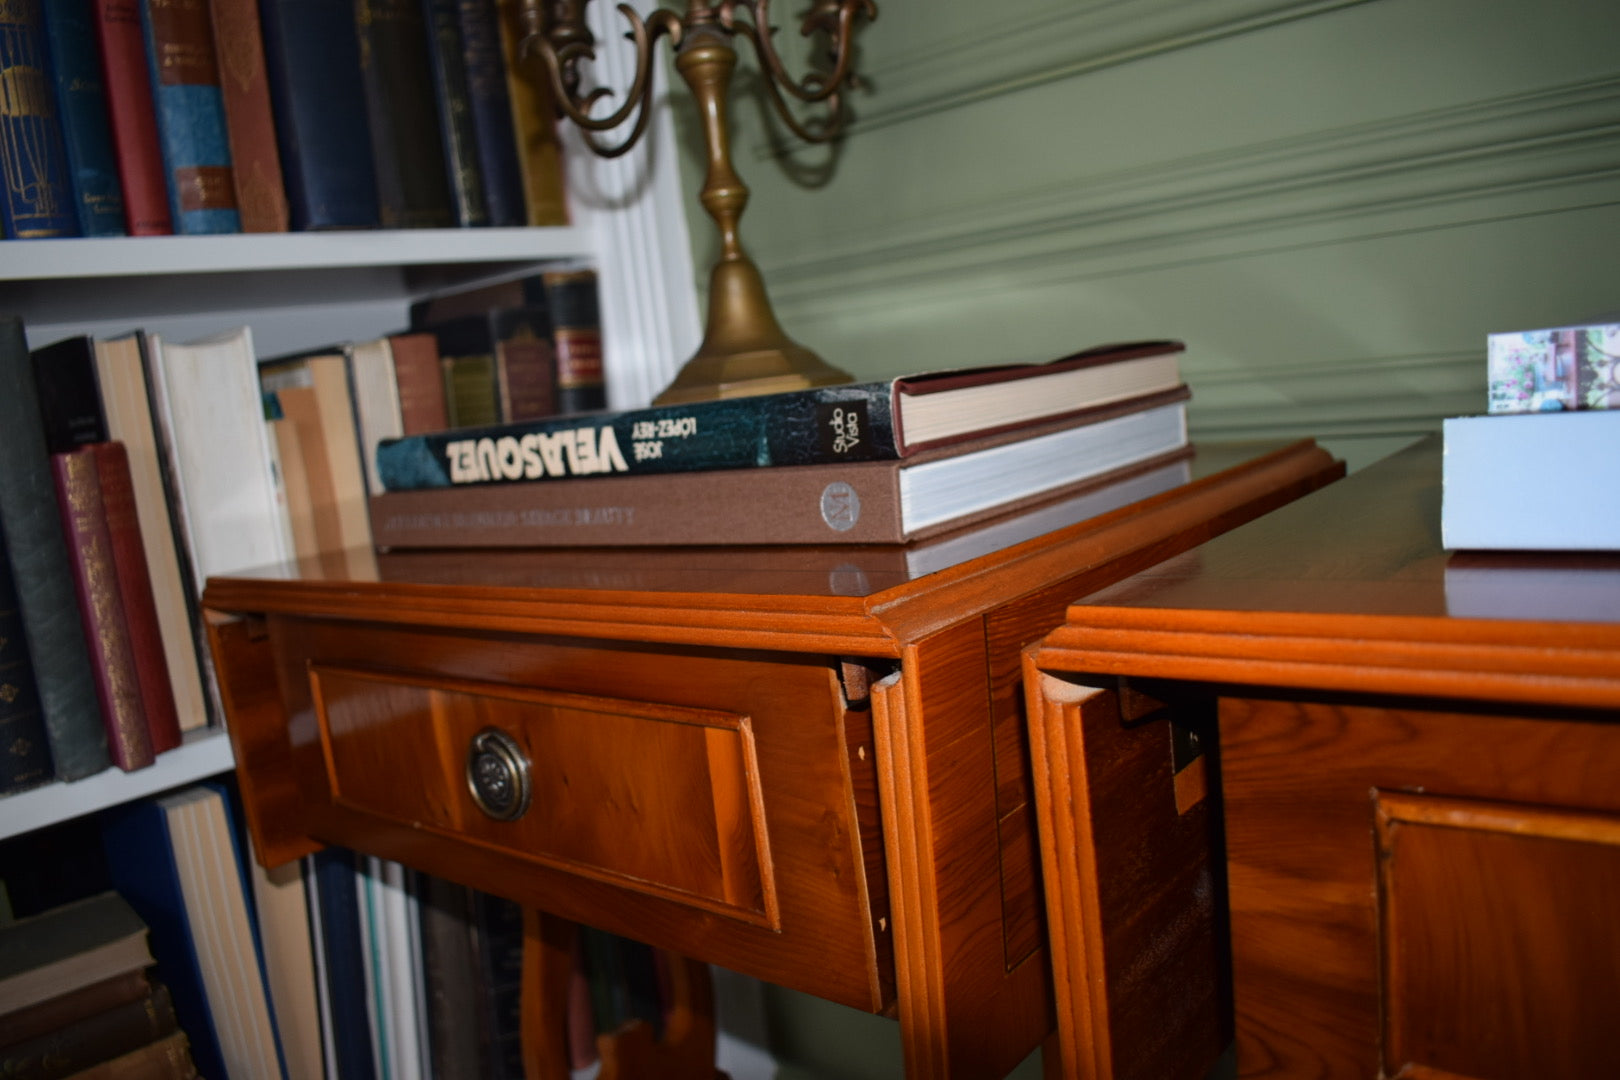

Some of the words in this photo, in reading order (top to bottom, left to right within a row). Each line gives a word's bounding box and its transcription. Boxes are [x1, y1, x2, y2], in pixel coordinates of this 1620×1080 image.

[631, 416, 697, 440] LÓPEZ-REY
[829, 408, 848, 453] Studio
[846, 412, 860, 448] Vista
[446, 425, 629, 485] VELASQUEZ
[632, 441, 664, 463] JOSÉ
